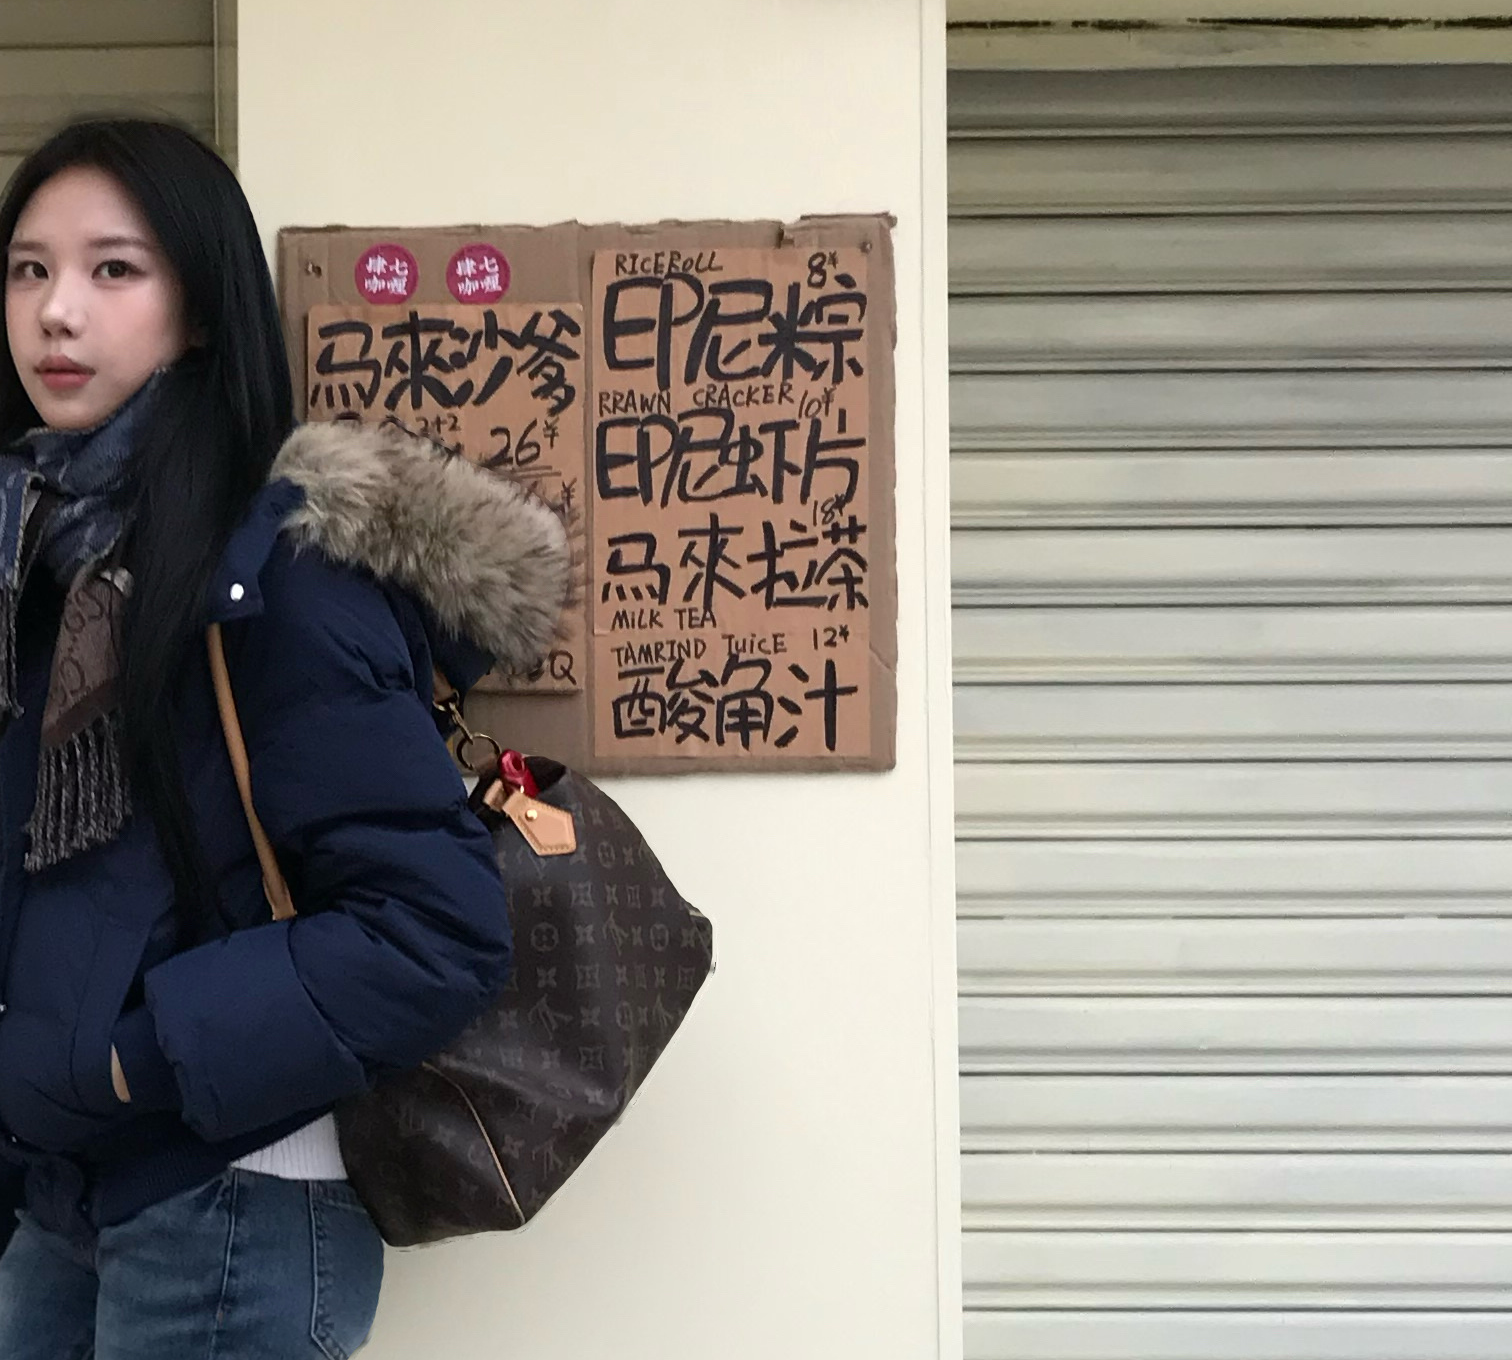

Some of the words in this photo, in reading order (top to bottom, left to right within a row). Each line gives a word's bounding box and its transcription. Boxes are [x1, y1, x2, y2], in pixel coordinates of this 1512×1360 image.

[603, 272, 868, 391] 印尼粽
[692, 383, 796, 409] CRACKER
[595, 406, 867, 510] 印尼虾片
[673, 606, 718, 631] TEA
[611, 654, 859, 751] 酸角汁
